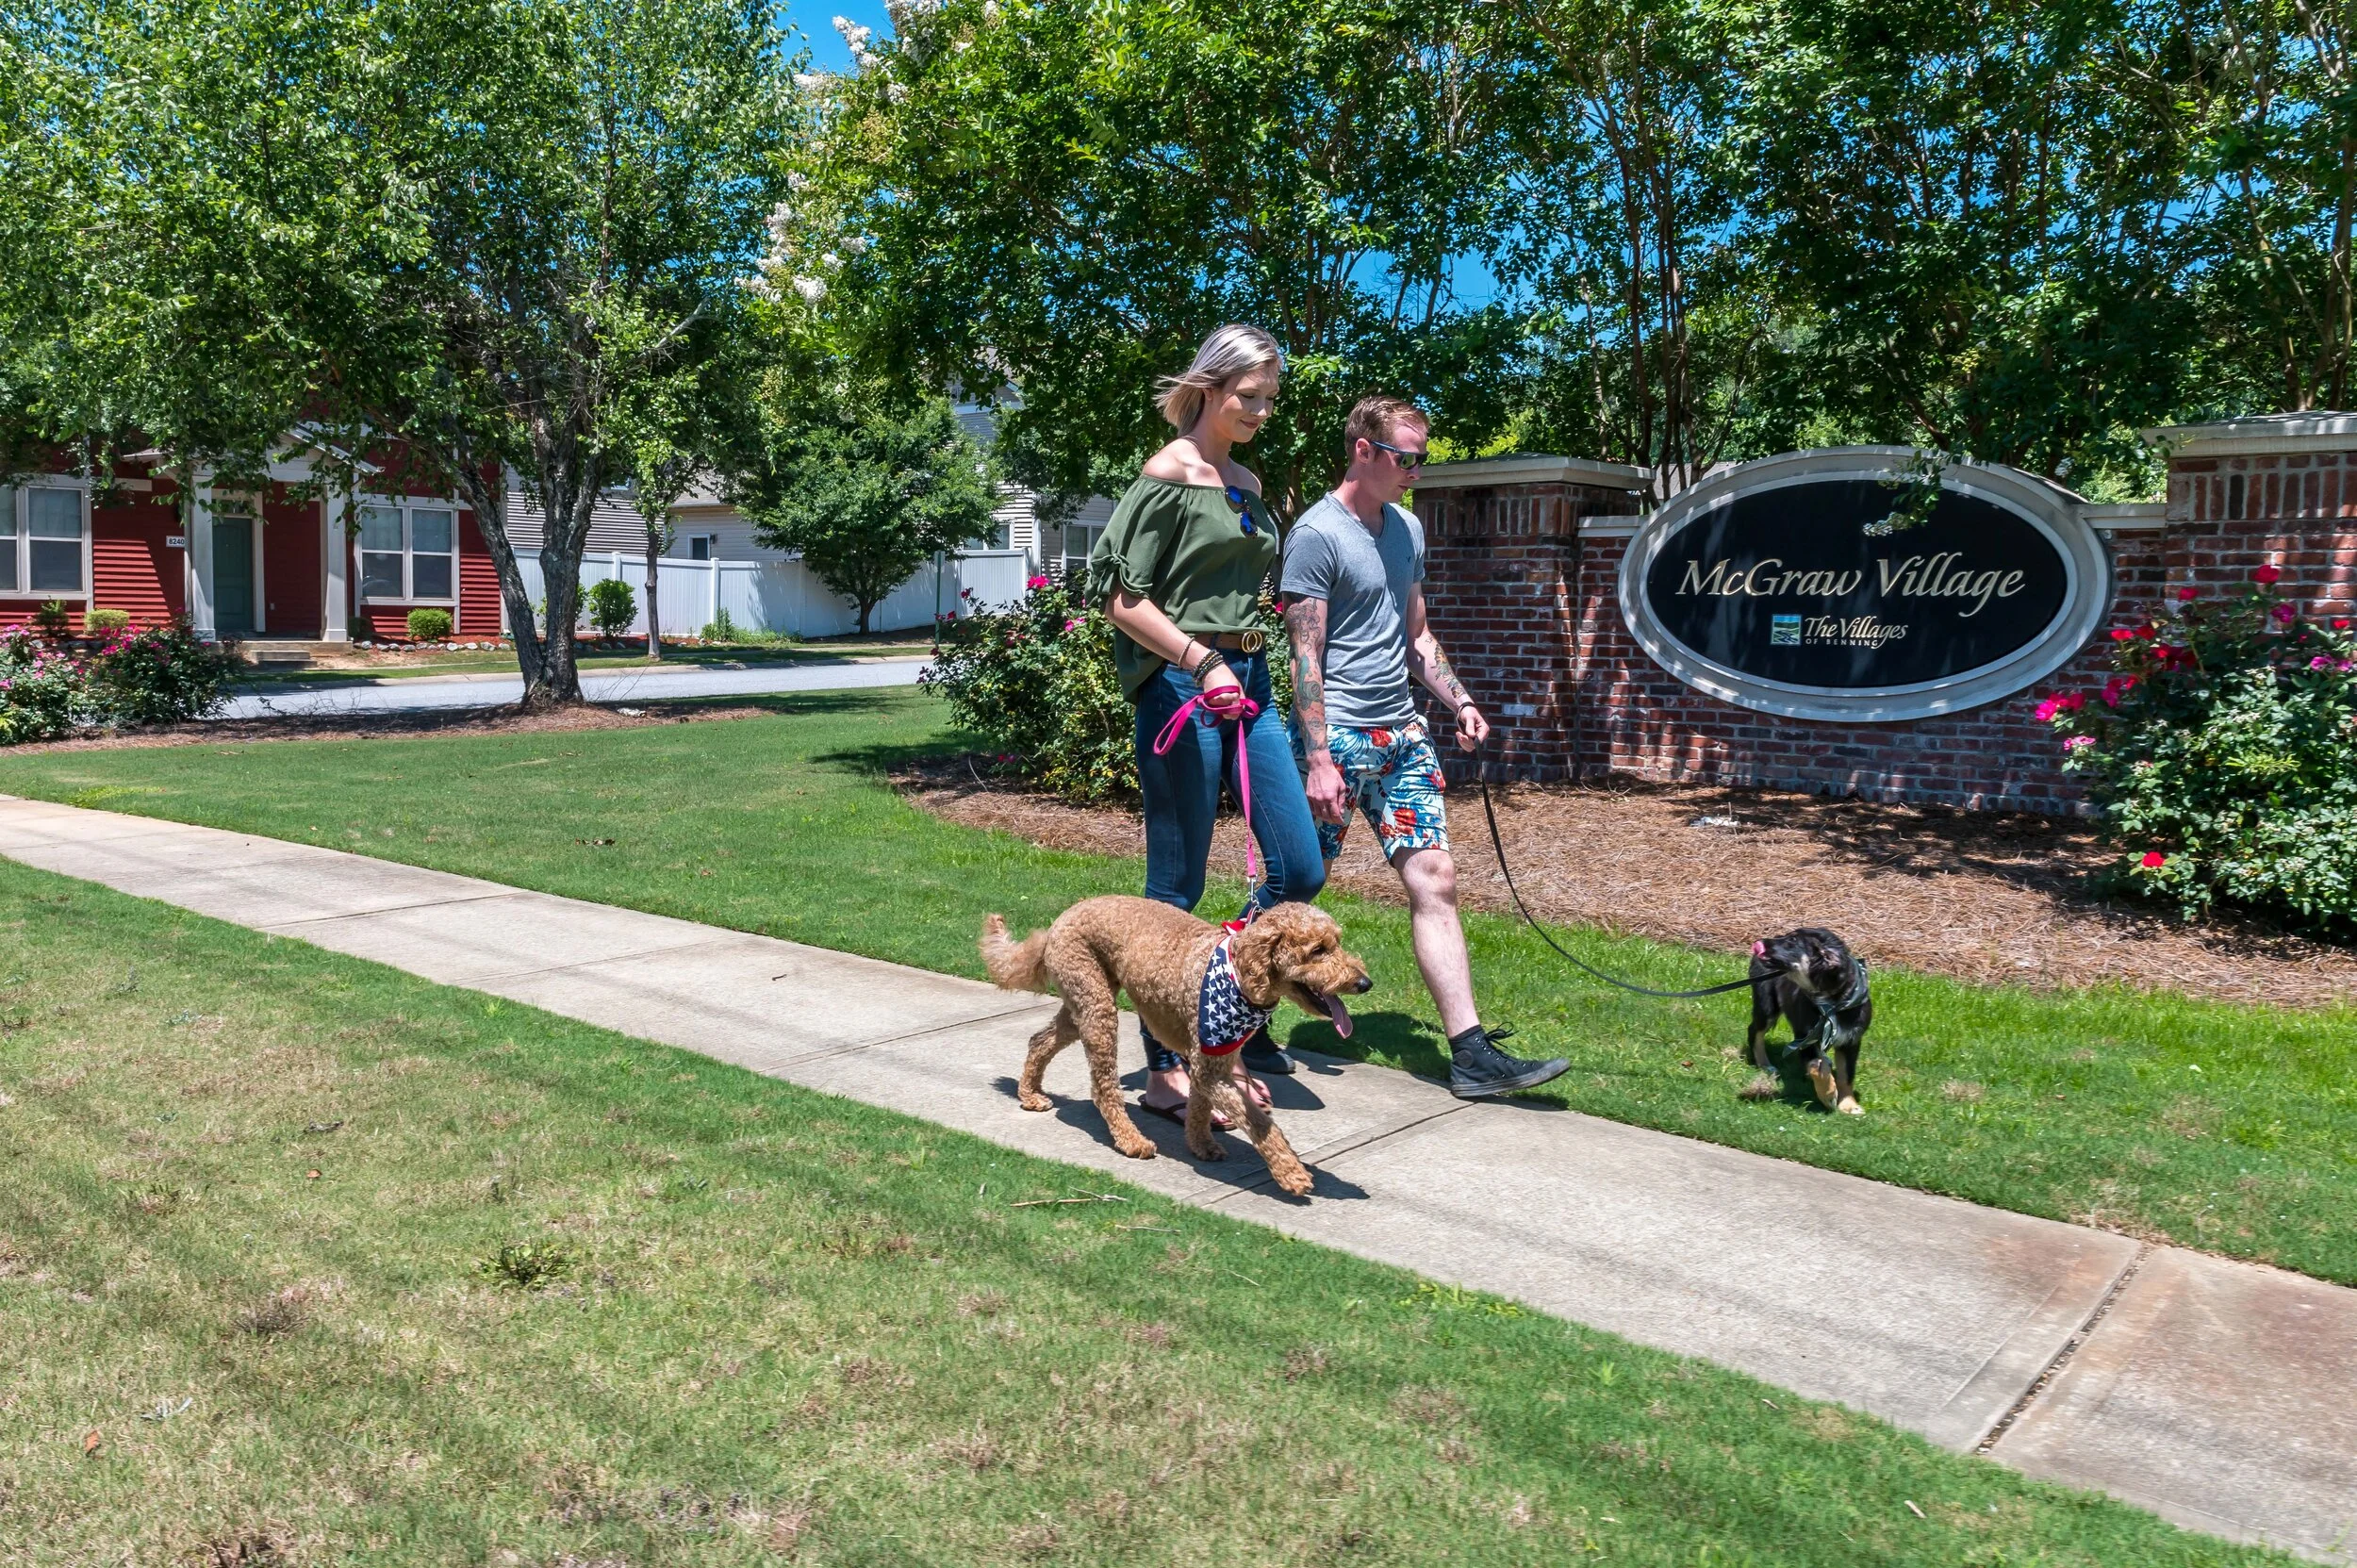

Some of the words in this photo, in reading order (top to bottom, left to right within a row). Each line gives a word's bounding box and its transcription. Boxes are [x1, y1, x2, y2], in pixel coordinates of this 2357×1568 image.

[1674, 558, 1862, 596] McGraw
[1876, 552, 2026, 618] Village
[1804, 615, 1838, 637] The
[1839, 616, 1909, 650] Villages
[1825, 638, 1878, 647] BENNING
